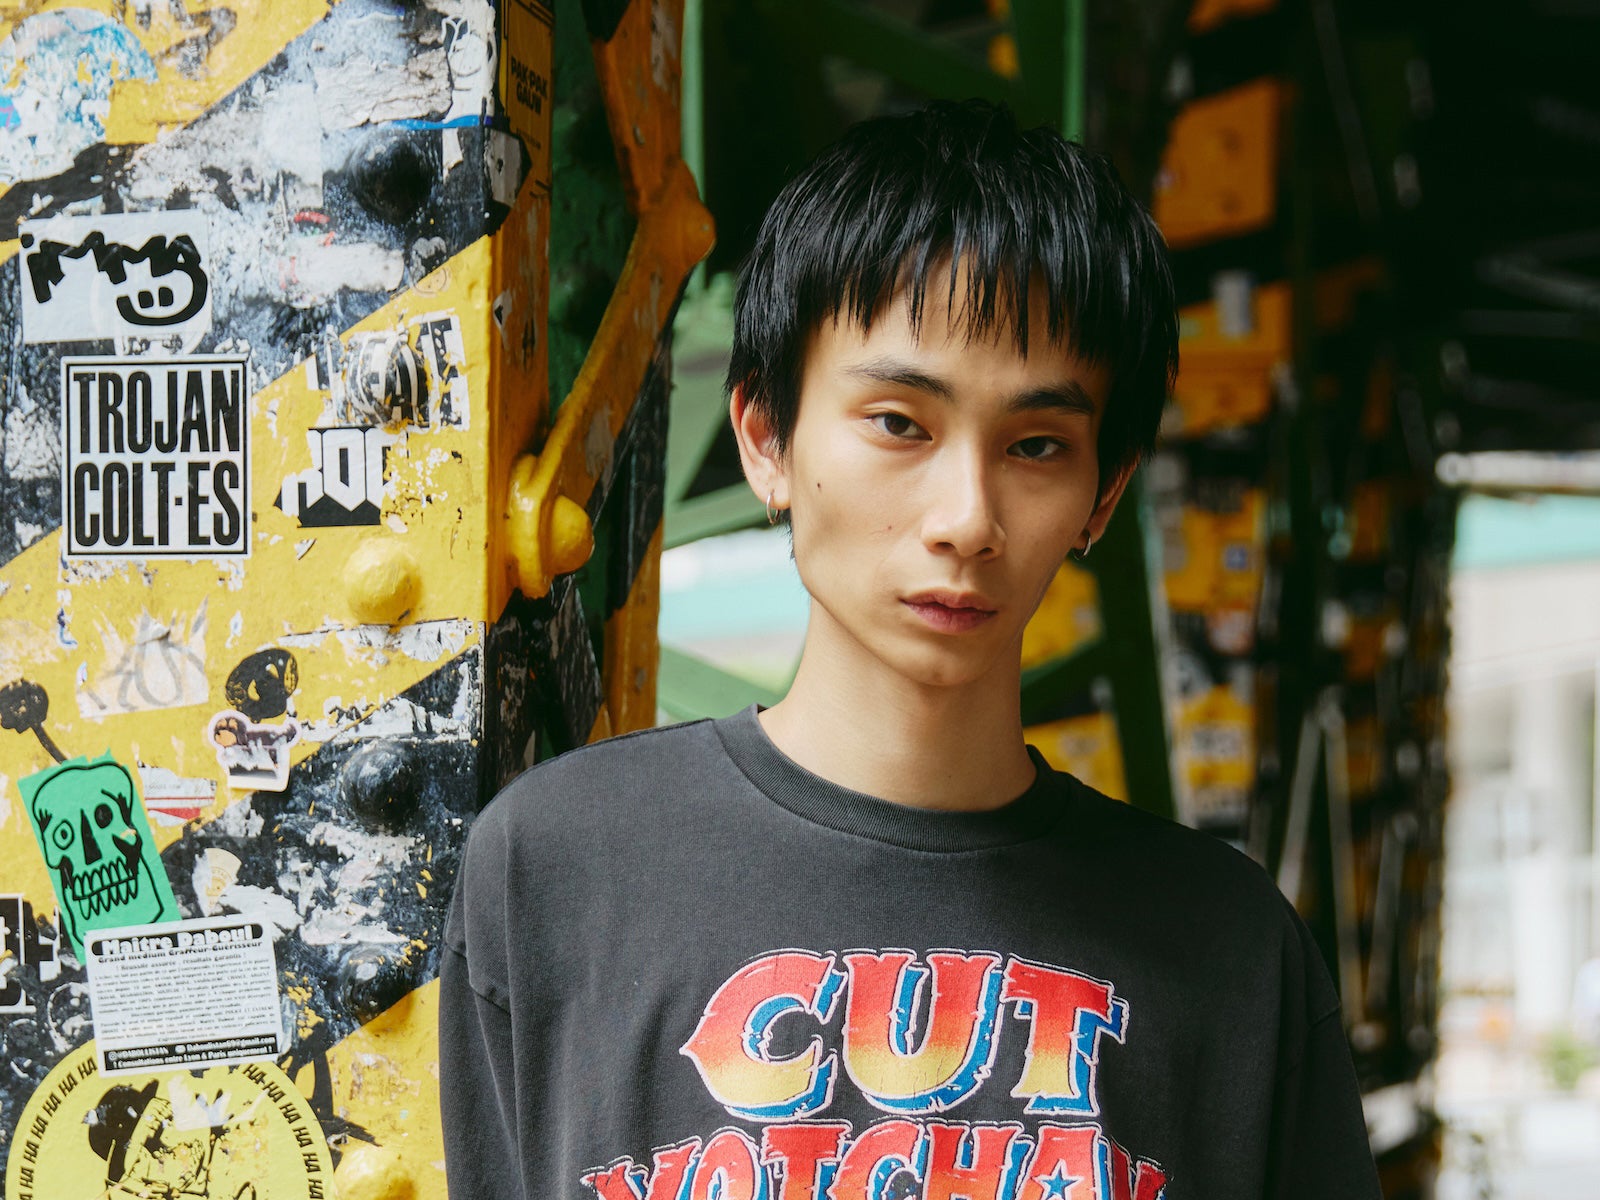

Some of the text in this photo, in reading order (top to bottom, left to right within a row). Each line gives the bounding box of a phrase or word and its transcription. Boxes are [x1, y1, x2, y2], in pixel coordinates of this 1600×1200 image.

[73, 370, 240, 454] TROJAN
[177, 925, 253, 947] Daboul
[679, 947, 1129, 1120] CUT
